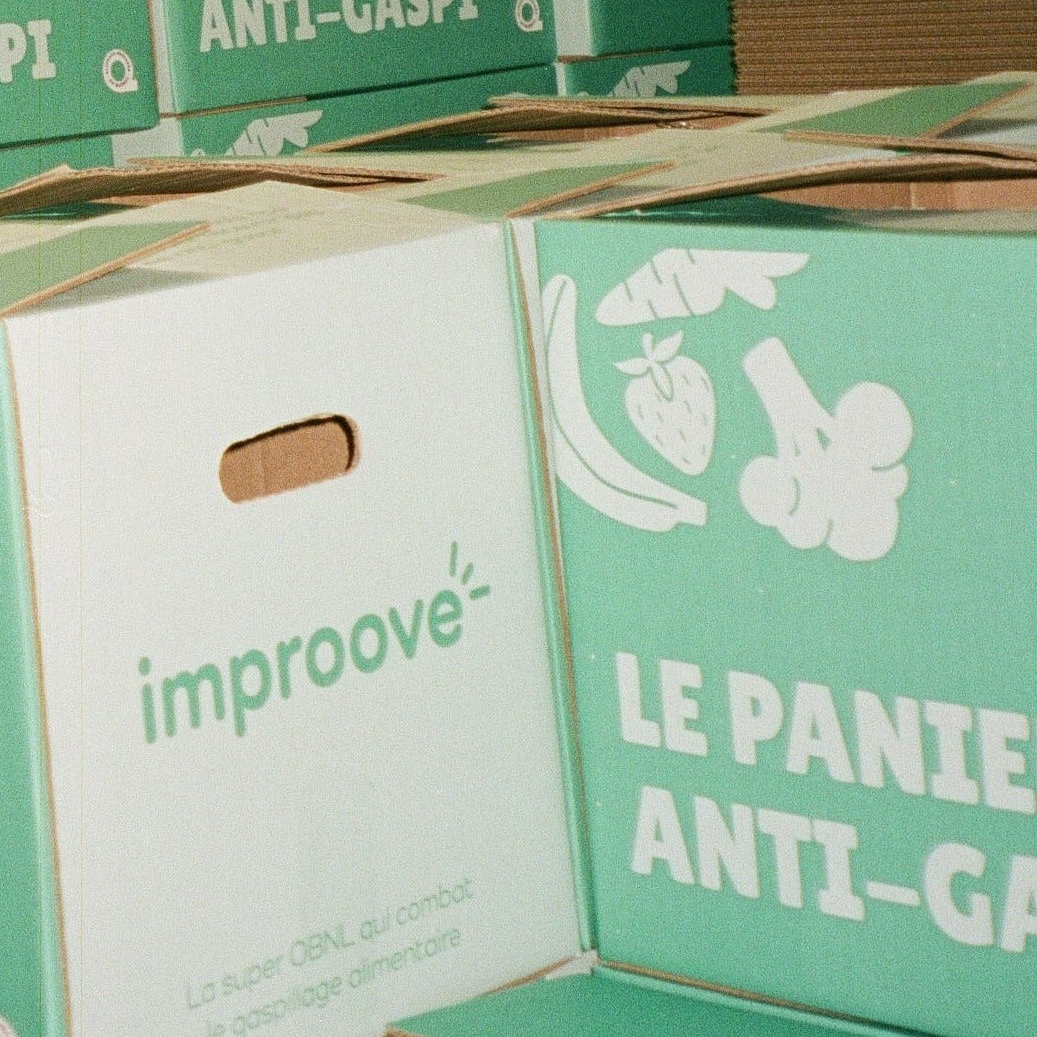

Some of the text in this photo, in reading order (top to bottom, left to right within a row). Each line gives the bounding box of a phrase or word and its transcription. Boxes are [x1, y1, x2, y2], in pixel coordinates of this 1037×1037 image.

[138, 589, 463, 744] improove
[614, 651, 1036, 815] LE PANIE
[185, 974, 215, 1010] La
[222, 955, 285, 998] super
[290, 922, 355, 967] OBNL
[395, 877, 473, 926] combat
